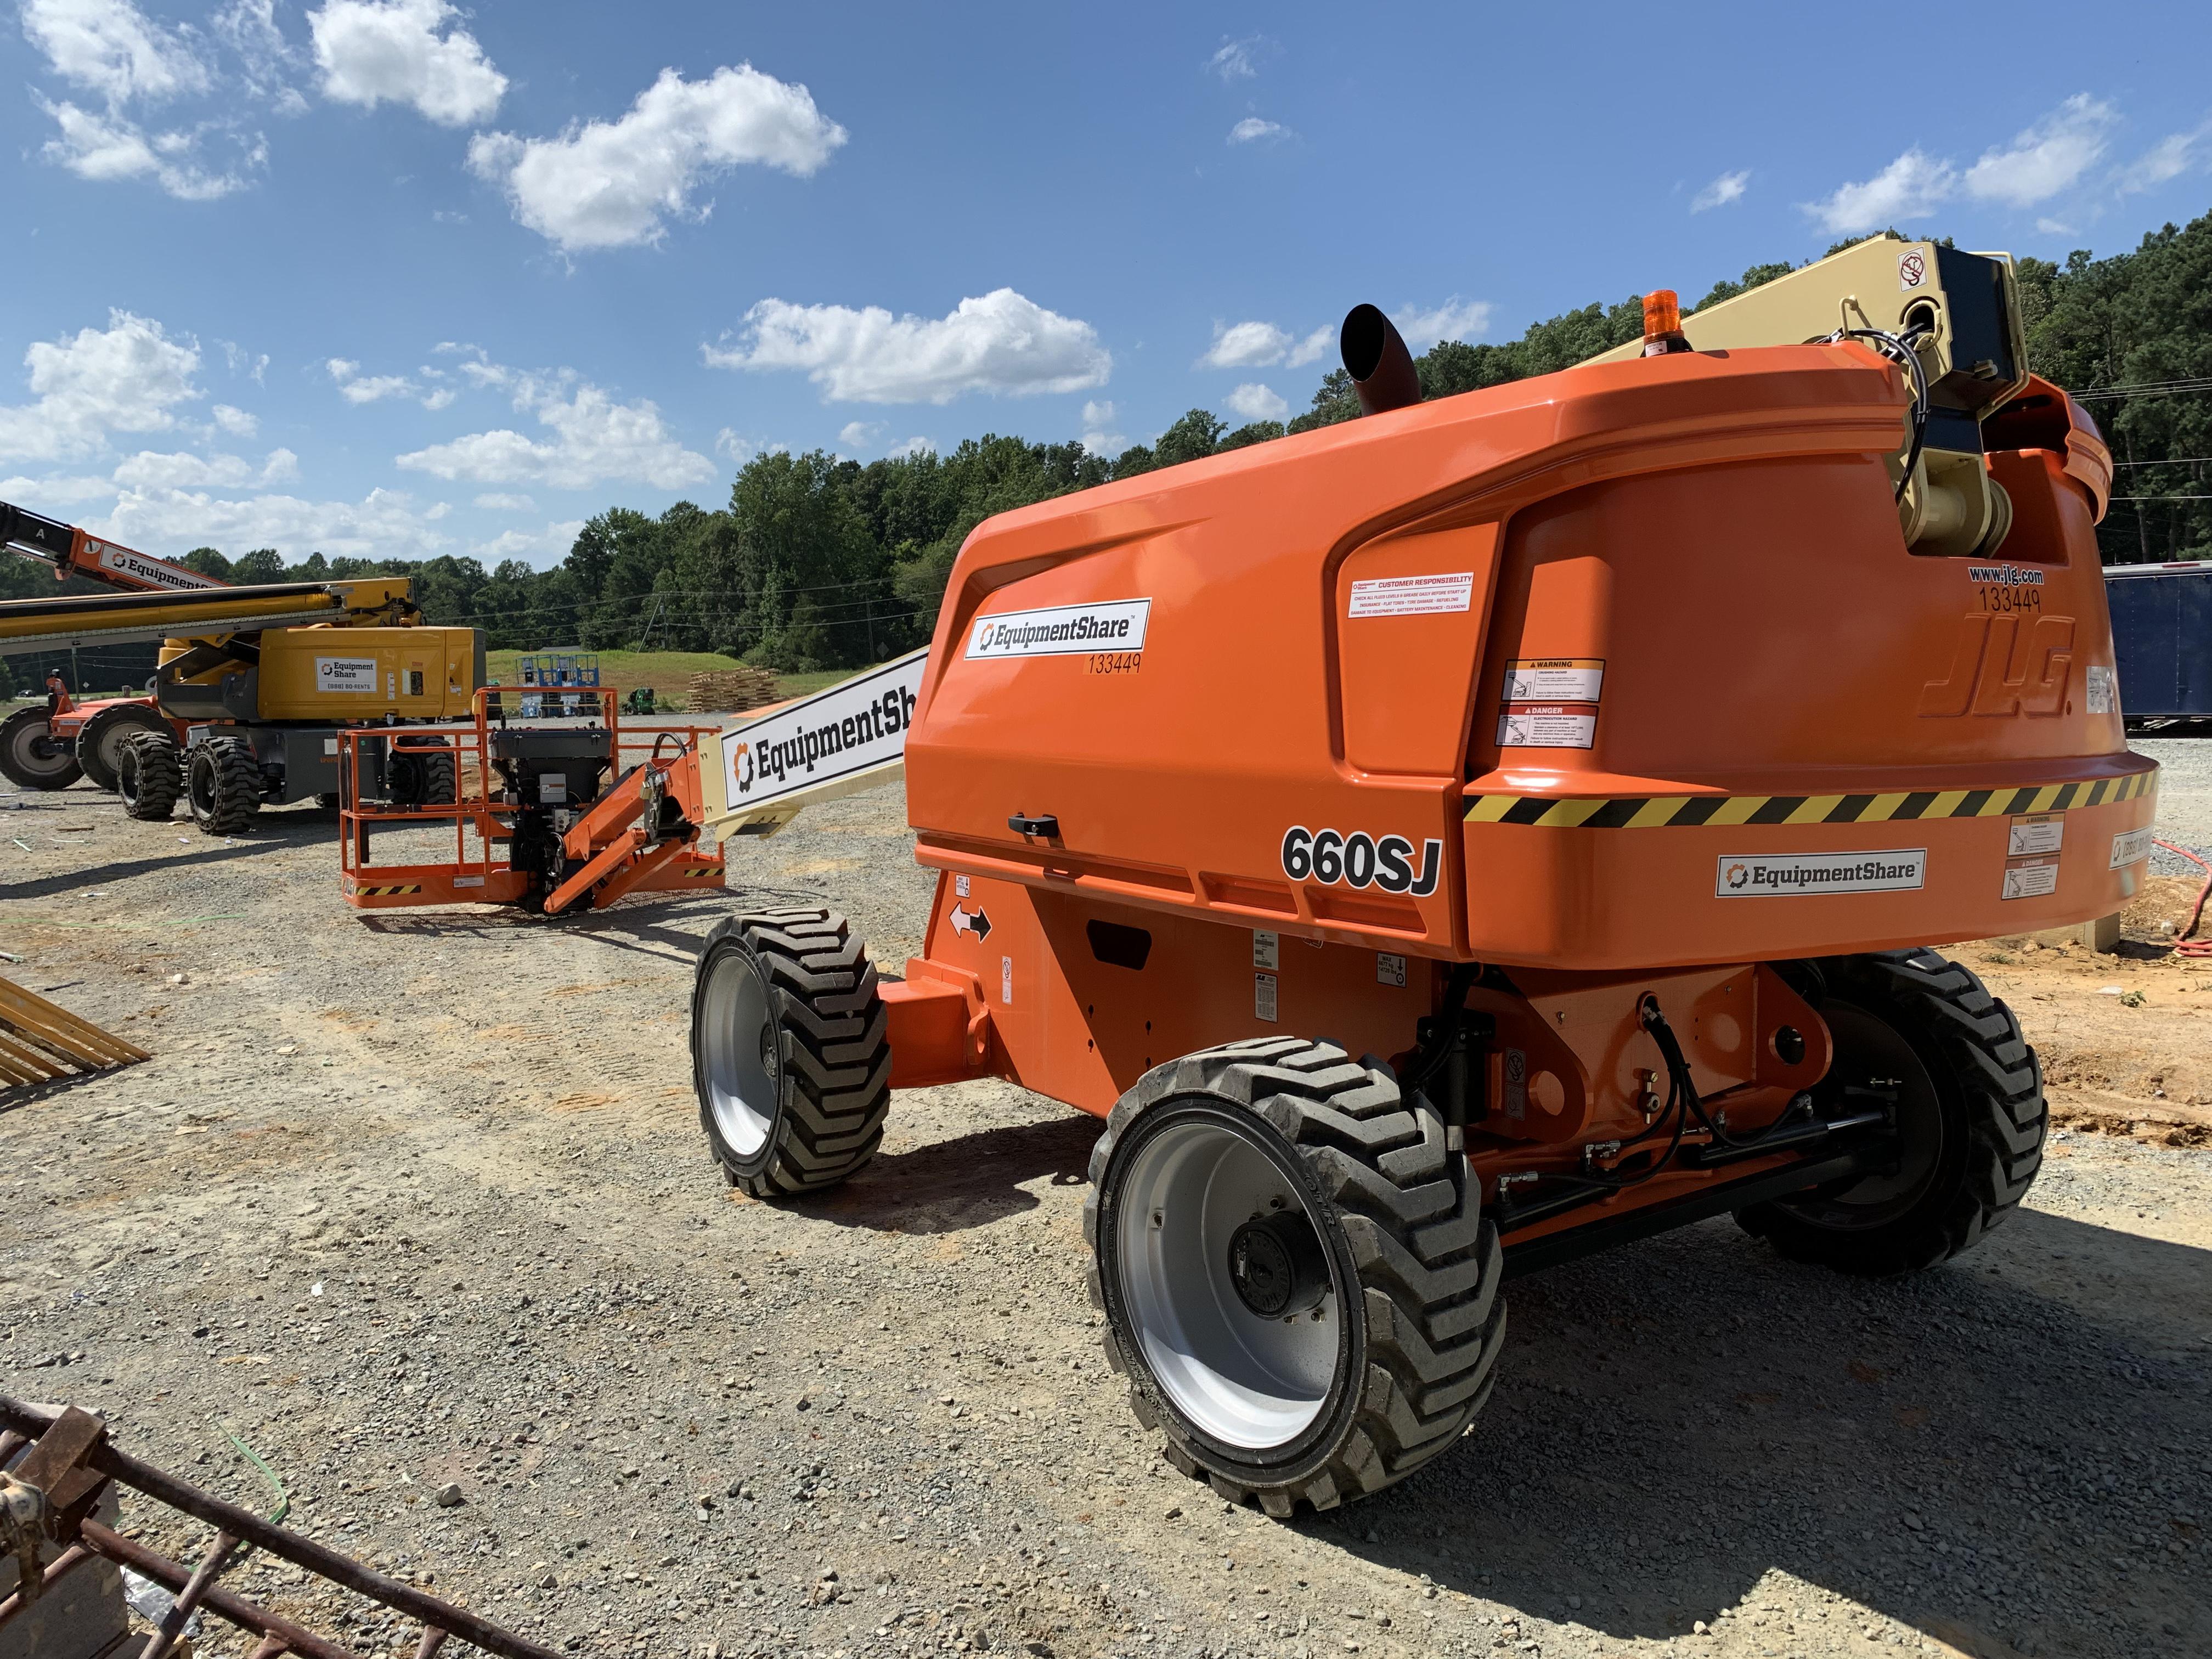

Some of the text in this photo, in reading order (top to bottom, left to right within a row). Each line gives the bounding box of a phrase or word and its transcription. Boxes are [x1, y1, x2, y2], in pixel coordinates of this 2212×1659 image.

[36, 528, 44, 539] A
[1378, 575, 1472, 588] CUSTOMER RESPONSIBILITY
[1968, 564, 2044, 587] www.jlg.com
[1979, 586, 2041, 613] 133449
[994, 615, 1130, 650] EquipmentShare
[334, 662, 374, 670] Equipment
[1088, 653, 1141, 674] 133449
[1918, 612, 2076, 720] JLG
[1281, 825, 1443, 897] 660SJ
[1752, 862, 1915, 888] EquipmentShare
